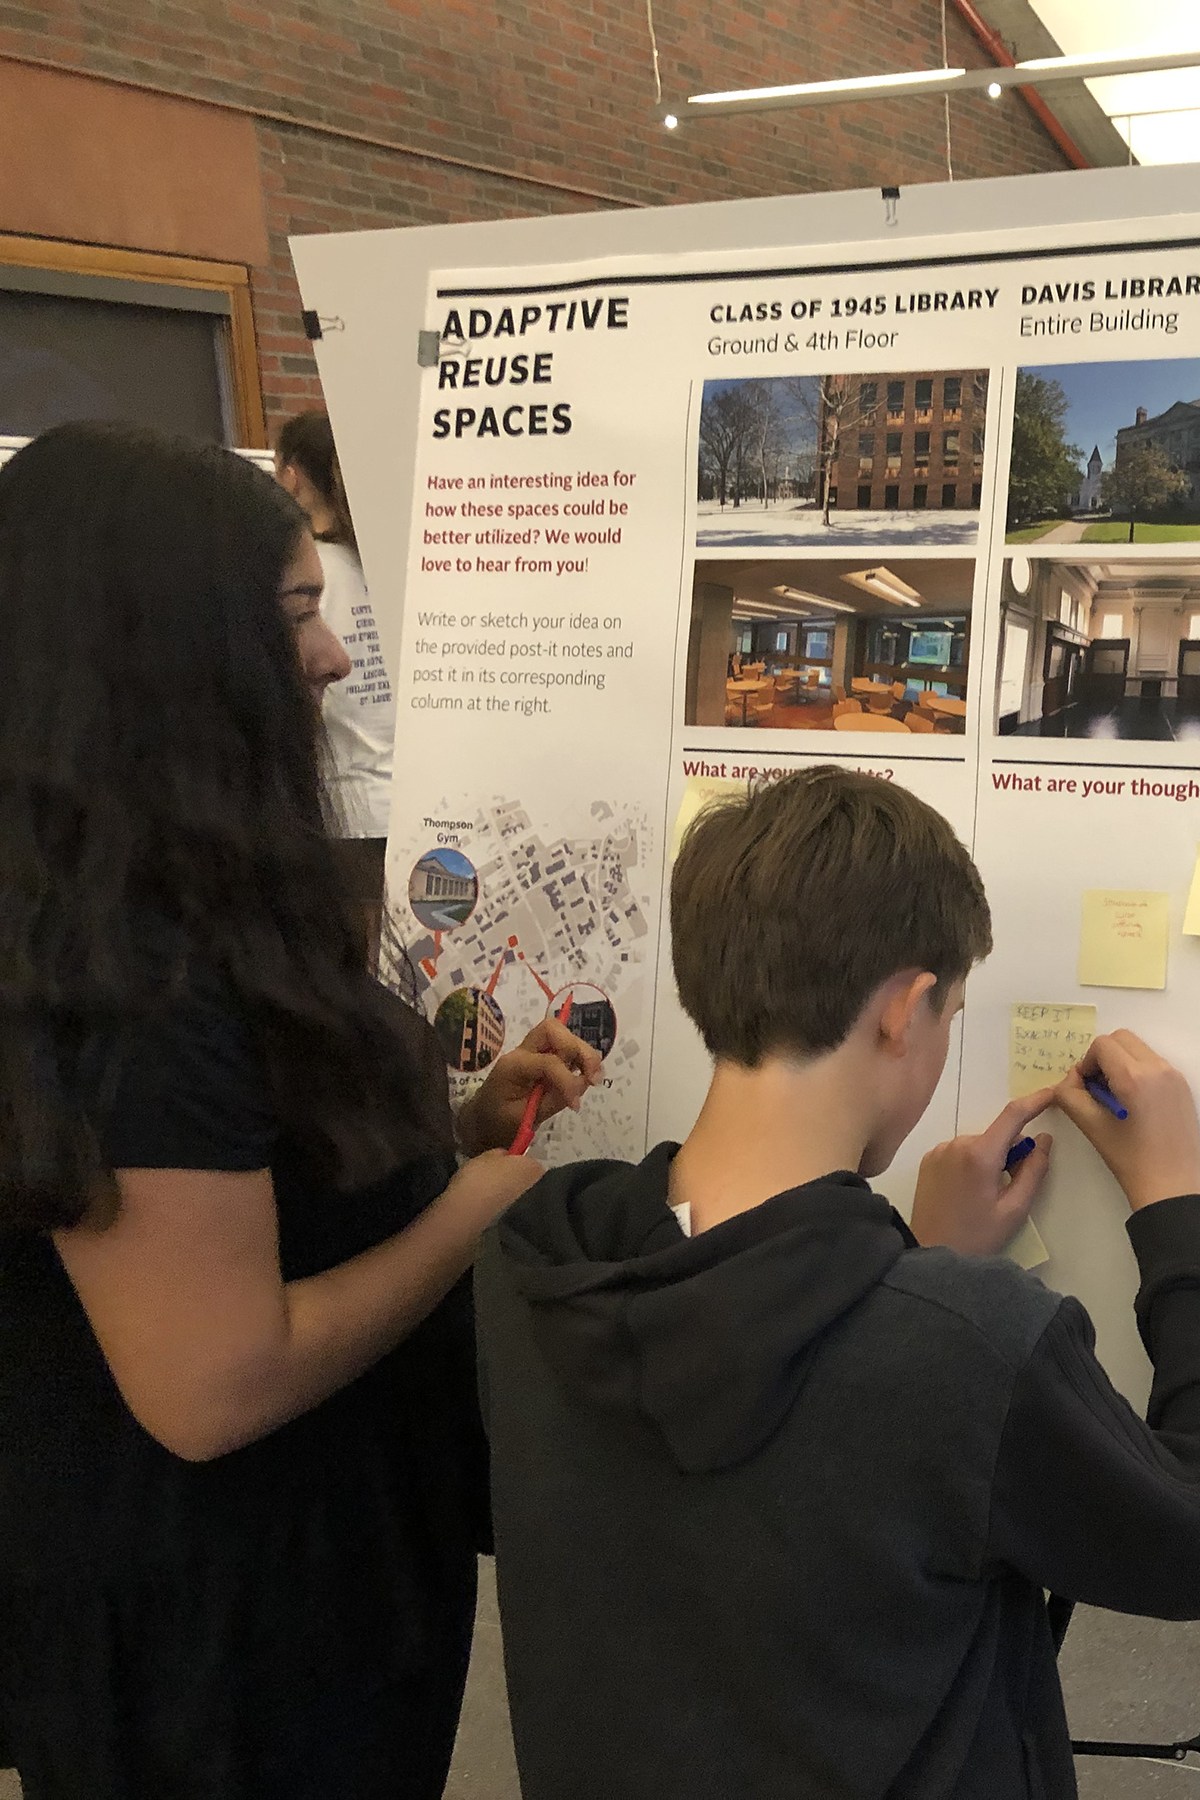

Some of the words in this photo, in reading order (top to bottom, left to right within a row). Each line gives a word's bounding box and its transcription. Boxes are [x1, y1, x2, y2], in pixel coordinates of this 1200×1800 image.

[1022, 281, 1095, 305] DAVIS
[710, 301, 782, 323] CLASS
[791, 299, 822, 319] OF
[831, 296, 886, 317] 1945
[896, 287, 999, 313] LIBRARY
[441, 297, 629, 341] ADAPTIVE
[1021, 313, 1082, 336] Entire
[1090, 308, 1177, 333] Building
[708, 332, 778, 355] Ground
[784, 332, 798, 352] &
[806, 330, 838, 350] 4th
[846, 328, 898, 348] Floor
[439, 353, 553, 389] REUSE
[433, 402, 571, 439] SPACES
[428, 475, 463, 489] Have
[468, 477, 485, 489] an
[490, 471, 572, 491] interesting
[577, 471, 608, 487] idea
[614, 469, 636, 486] for
[426, 501, 456, 517] how
[461, 501, 503, 517] these
[508, 503, 558, 520] spaces
[564, 499, 604, 516] could
[610, 498, 628, 515] be
[424, 529, 471, 544] better
[475, 528, 540, 544] utilized?
[545, 529, 569, 544] We
[575, 527, 621, 544] would
[422, 556, 451, 571] love
[456, 557, 471, 572] to
[476, 556, 511, 572] hear
[515, 556, 552, 572] from
[556, 557, 588, 576] you!
[418, 611, 456, 627] Write
[461, 615, 476, 627] or
[481, 611, 527, 628] sketch
[533, 616, 565, 632] your
[570, 612, 598, 629] idea
[603, 616, 621, 629] on
[416, 638, 437, 654] the
[442, 639, 505, 657] provided
[510, 640, 557, 659] post-it
[563, 642, 602, 657] notes
[607, 641, 633, 658] and
[413, 667, 443, 684] post
[448, 668, 457, 682] it
[462, 667, 474, 682] in
[479, 668, 495, 683] its
[500, 668, 605, 690] corresponding
[411, 692, 462, 709] column
[467, 696, 481, 710] at
[486, 695, 510, 711] the
[515, 696, 551, 716] right.
[683, 760, 726, 777] What
[732, 766, 758, 779] are
[992, 772, 1041, 791] What
[1047, 778, 1077, 793] are
[1082, 780, 1125, 797] your
[423, 817, 473, 830] Thompson
[437, 832, 458, 845] Gym
